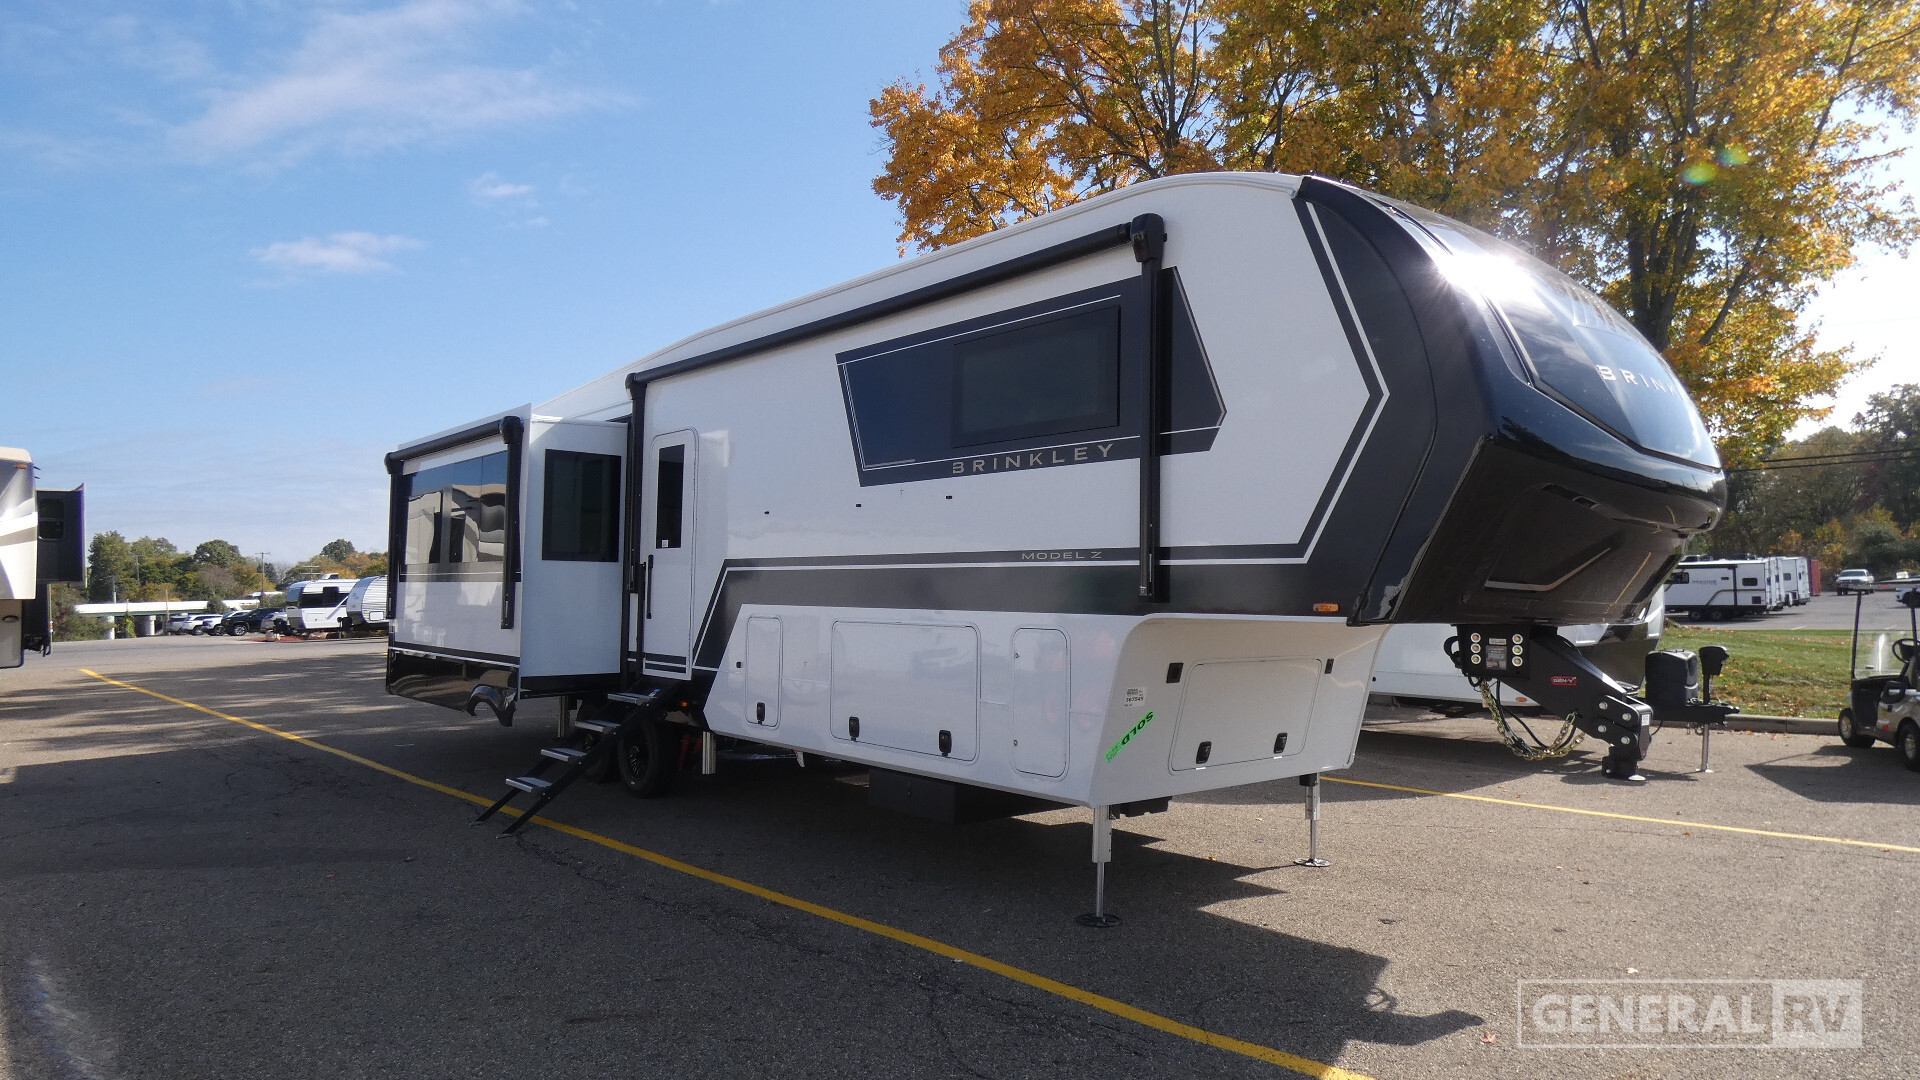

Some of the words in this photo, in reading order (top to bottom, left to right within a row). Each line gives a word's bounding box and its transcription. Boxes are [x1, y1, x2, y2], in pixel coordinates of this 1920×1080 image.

[952, 443, 1114, 474] BRINKLEY
[1021, 551, 1085, 560] MODEL
[1090, 551, 1102, 559] Z
[1121, 711, 1154, 746] SOLD
